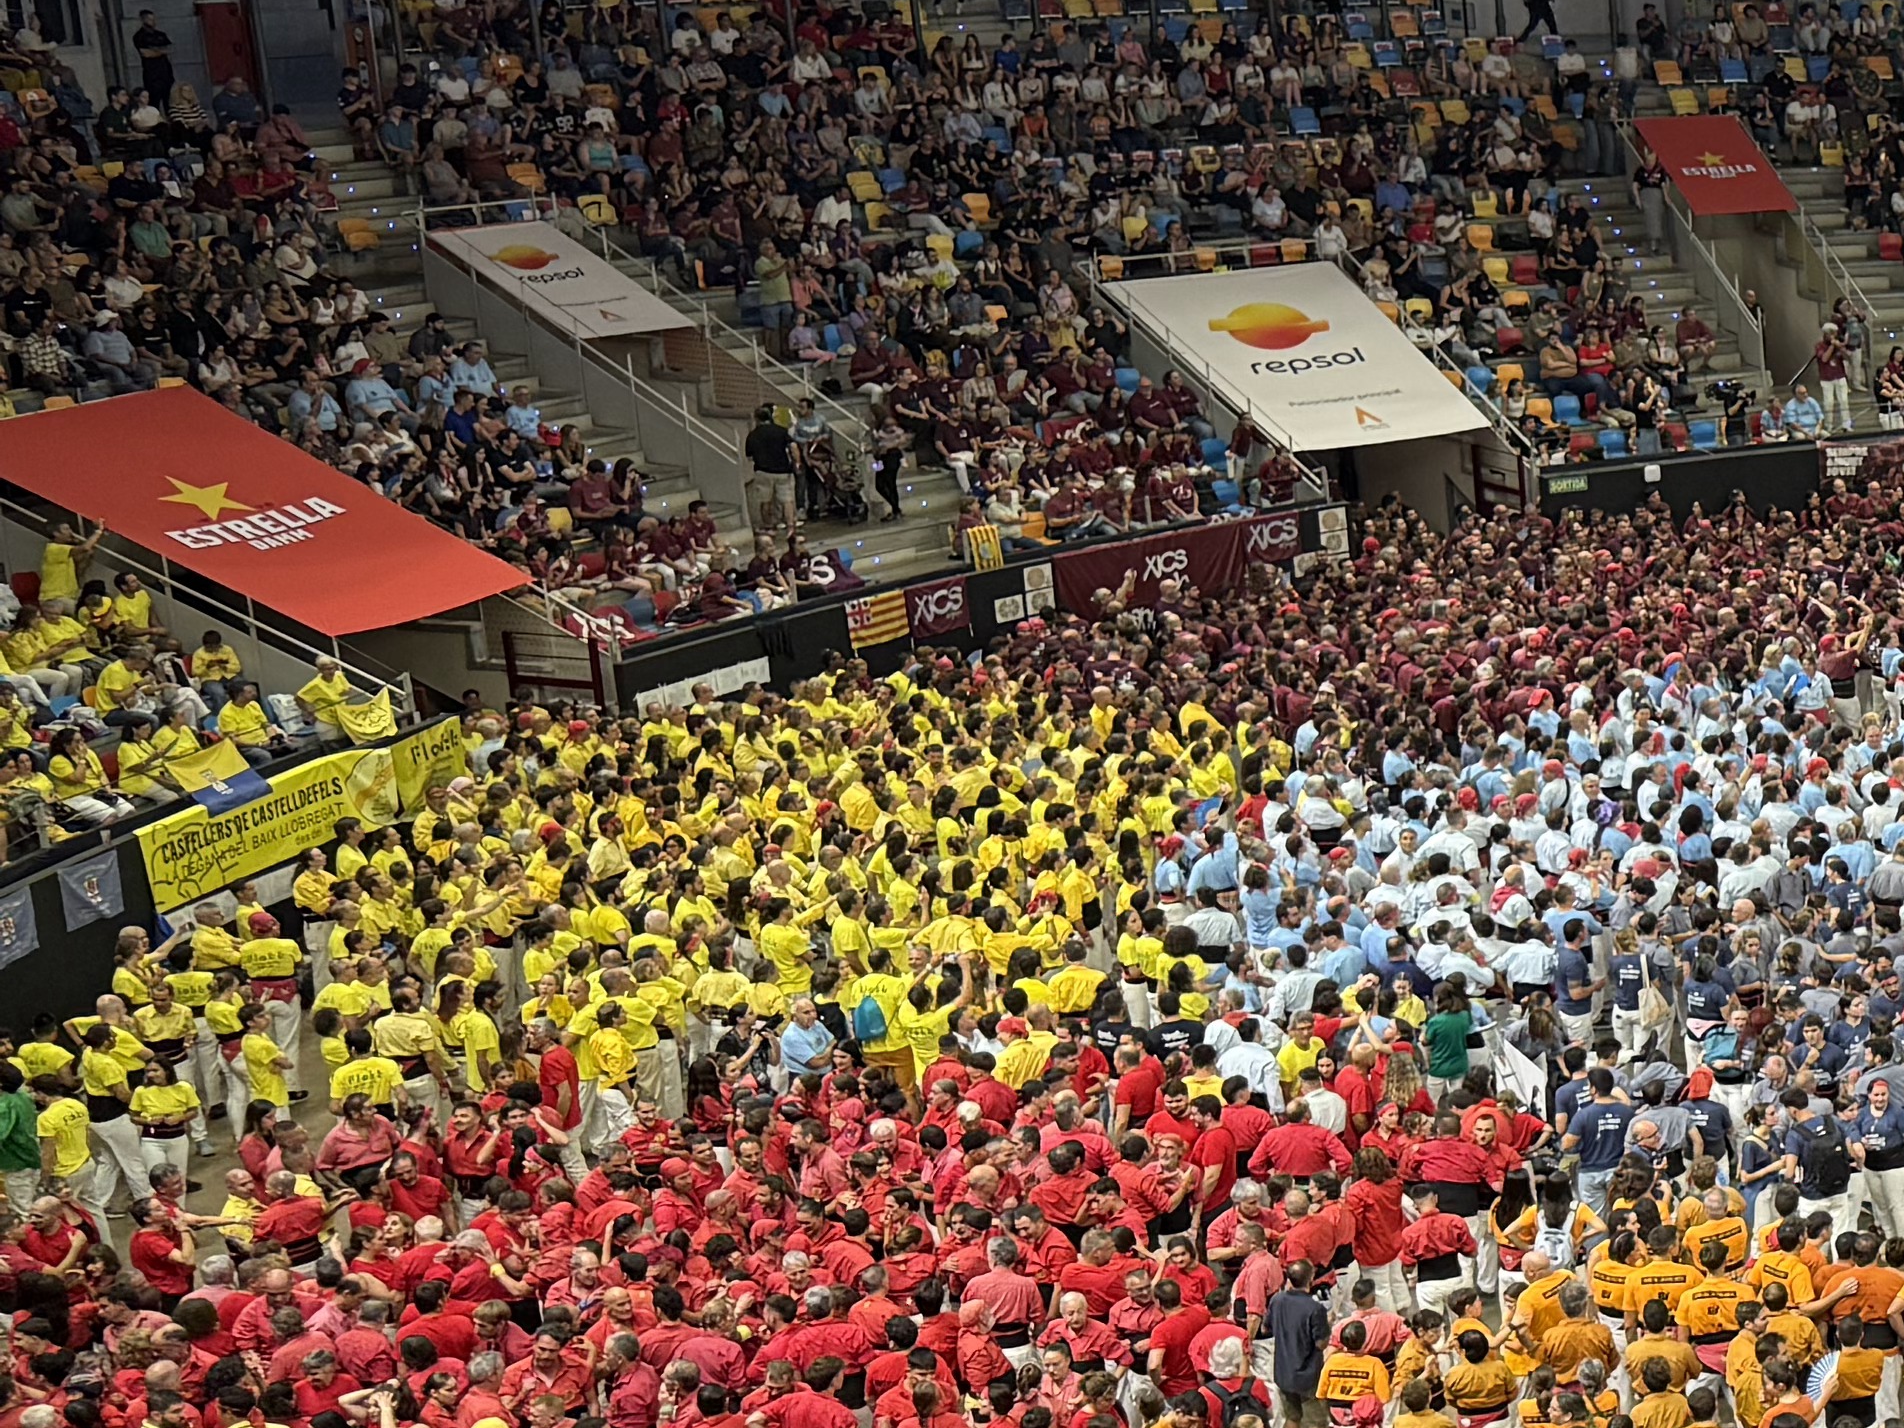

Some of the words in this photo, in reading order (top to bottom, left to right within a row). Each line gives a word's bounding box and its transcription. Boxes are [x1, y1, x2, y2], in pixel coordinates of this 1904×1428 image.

[1250, 347, 1367, 376] repsol
[164, 495, 347, 551] ESTRELLA
[248, 526, 316, 553] DAMM
[162, 818, 232, 863] CASTELLERS
[234, 815, 250, 838] DE
[251, 777, 343, 827] CASTELLDEFELS
[252, 831, 278, 850] BAIX
[280, 803, 344, 838] LLOBREGAT
